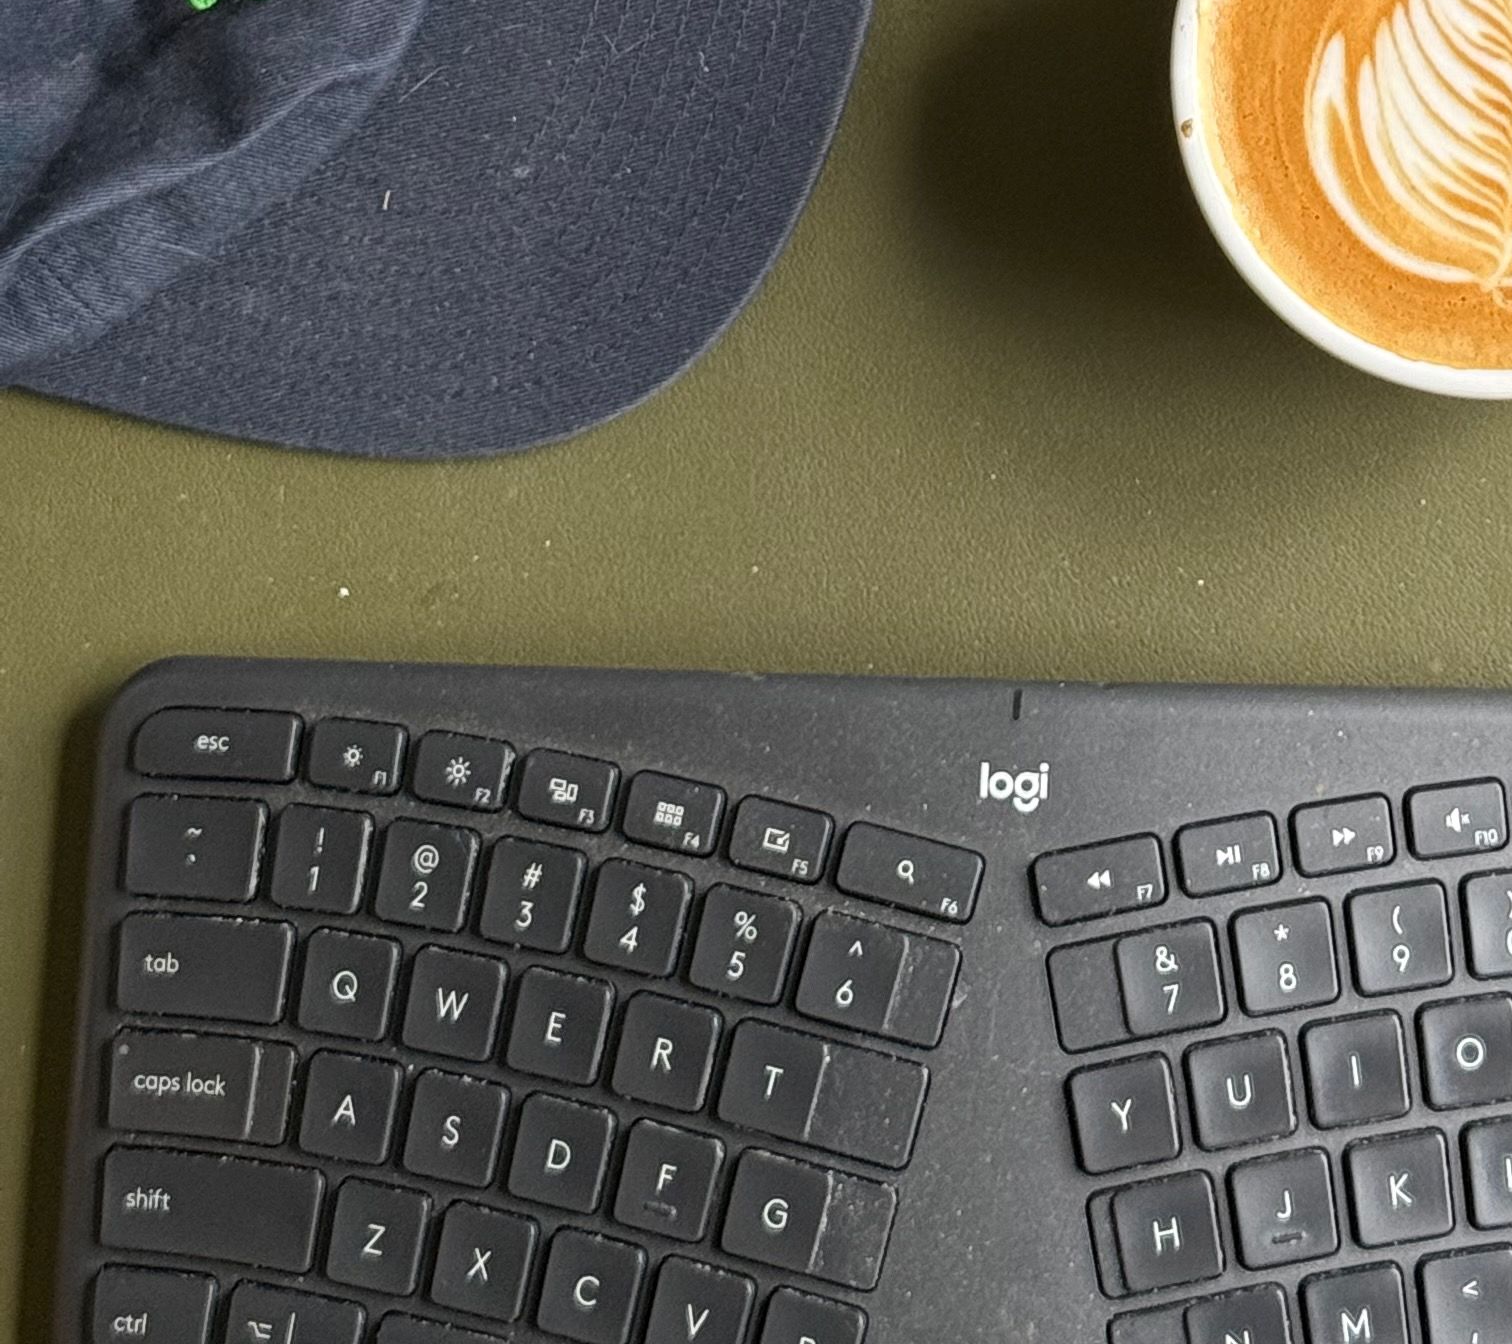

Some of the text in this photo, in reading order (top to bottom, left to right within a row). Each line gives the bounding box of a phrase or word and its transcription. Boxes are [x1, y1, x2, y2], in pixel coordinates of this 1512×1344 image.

[196, 732, 231, 752] esc
[979, 761, 1051, 813] logi
[1474, 828, 1499, 846] F10
[143, 953, 180, 974] tab
[133, 1072, 226, 1096] caps lock
[125, 1188, 171, 1211] shift
[113, 1313, 148, 1336] ctrl
